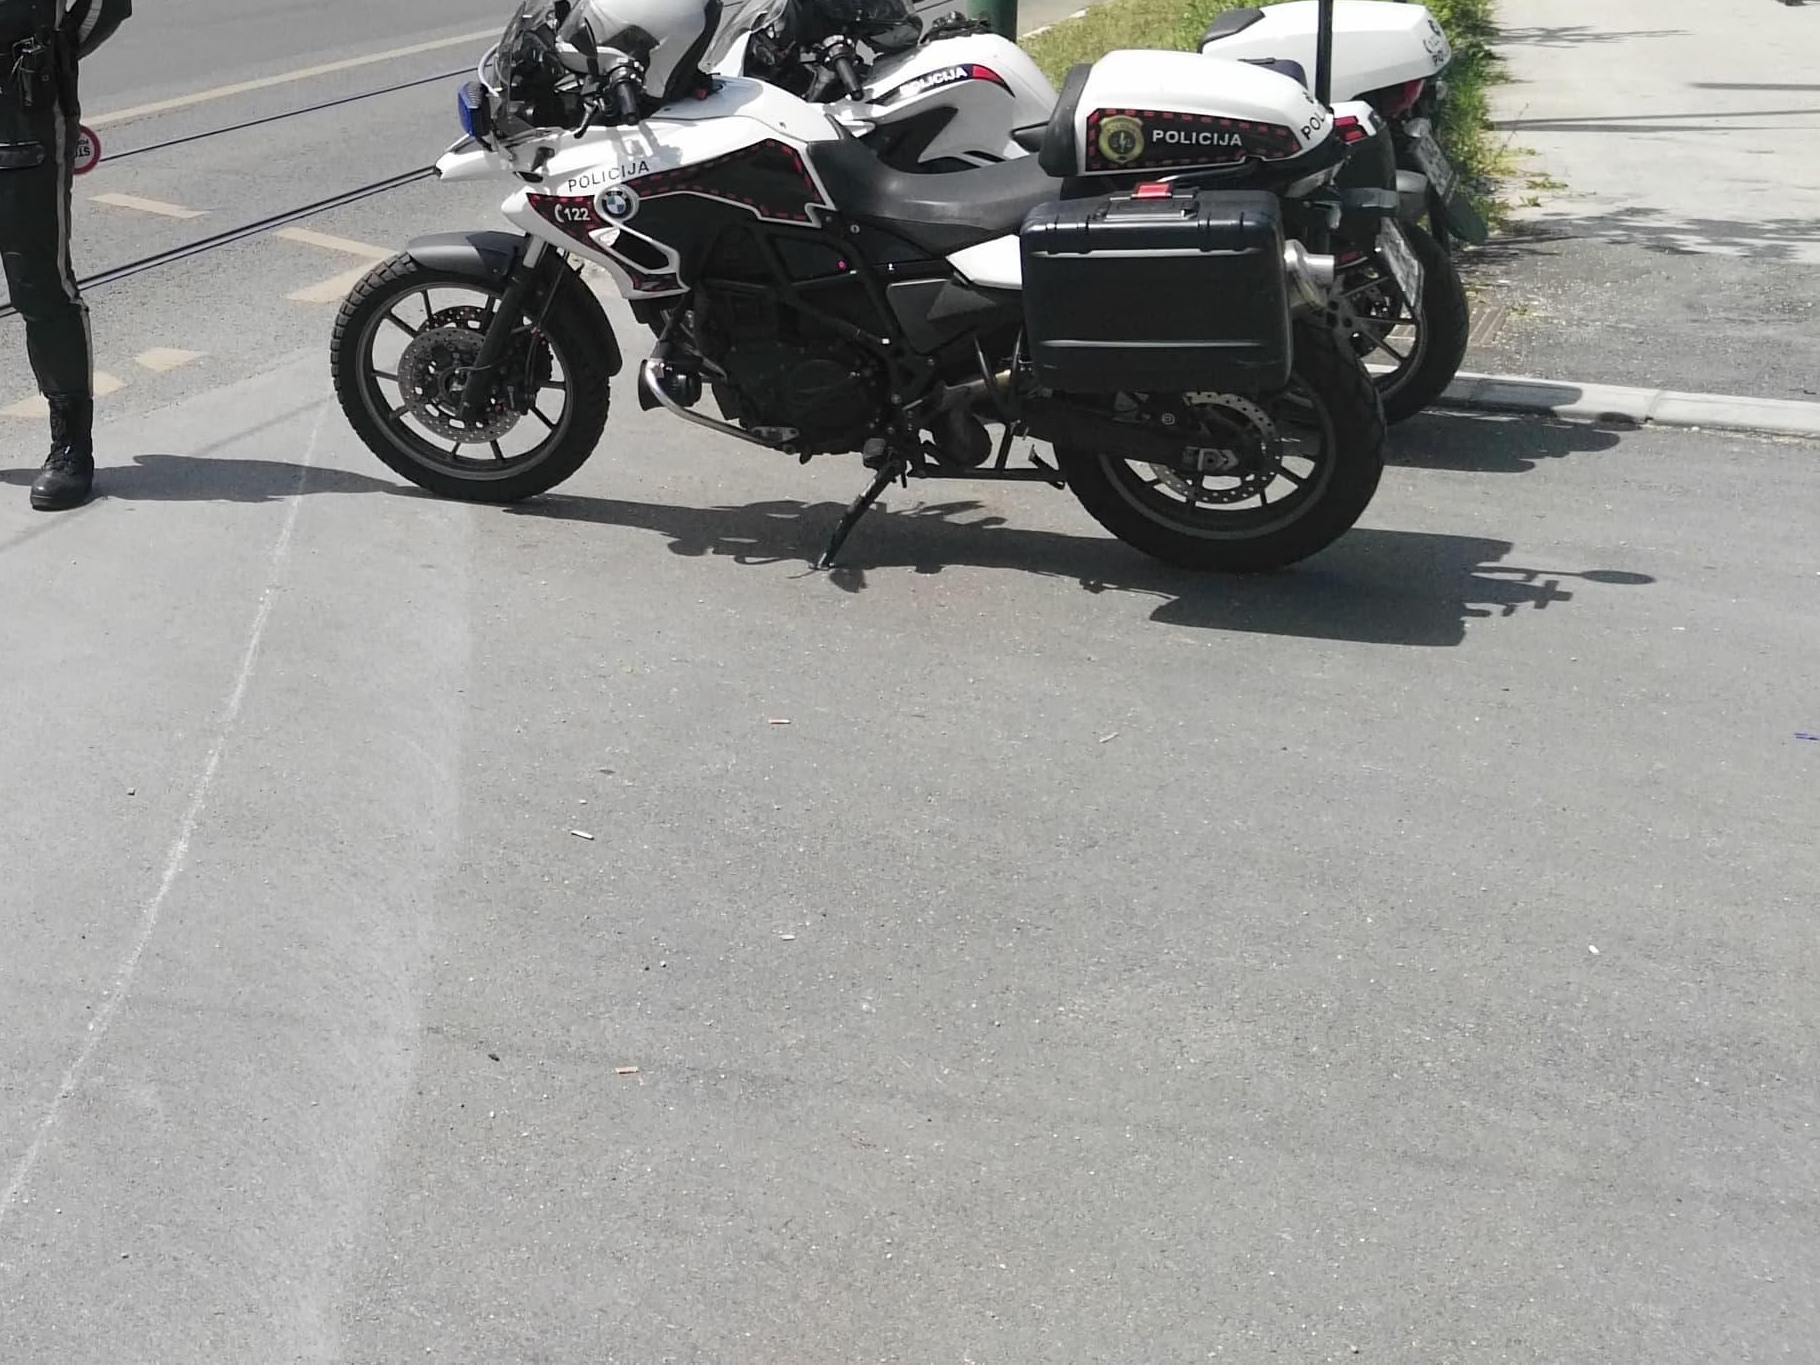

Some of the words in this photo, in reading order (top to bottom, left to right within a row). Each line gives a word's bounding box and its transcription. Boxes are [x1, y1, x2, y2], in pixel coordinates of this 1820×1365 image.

[1152, 130, 1242, 146] POLICIJA
[568, 160, 649, 192] POLICIJA
[564, 207, 590, 221] 122
